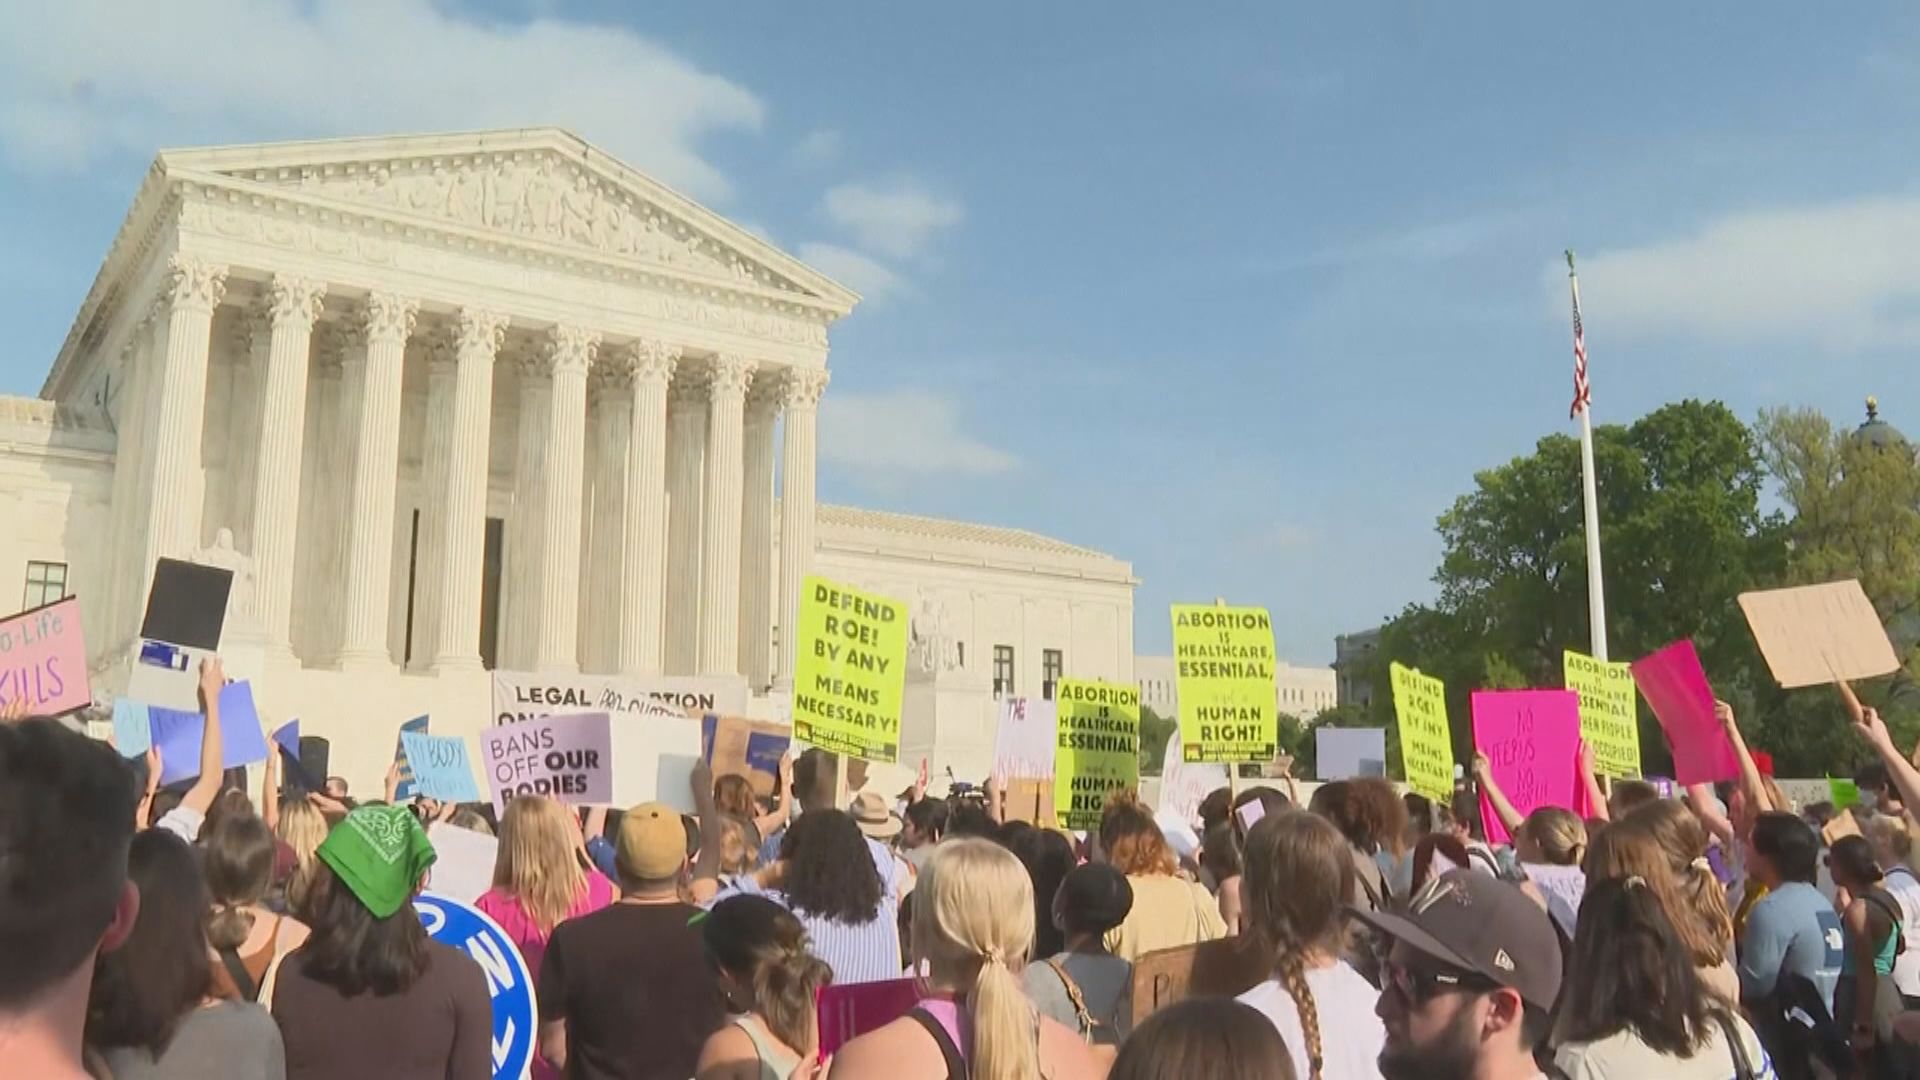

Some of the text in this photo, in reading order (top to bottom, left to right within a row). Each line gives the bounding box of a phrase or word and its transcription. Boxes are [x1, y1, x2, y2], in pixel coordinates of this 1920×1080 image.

[815, 584, 895, 622] DEFEND
[825, 615, 879, 647] ROE!
[1177, 612, 1270, 630] ABORTION
[1219, 632, 1231, 644] IS
[814, 638, 889, 675] BY ANY
[1178, 644, 1273, 660] HEALTHCARE,
[1179, 661, 1274, 681] ESSENTIAL,
[1568, 657, 1631, 680] ABORTION
[515, 686, 592, 707] LEGAL
[815, 674, 879, 706] MEANS
[1060, 684, 1139, 706] ABORTION
[796, 694, 897, 733] NECESSARY!
[1098, 706, 1109, 718] IS
[1197, 706, 1262, 721] HUMAN
[491, 728, 554, 760] BANS
[1059, 733, 1137, 756] ESSENTIAL,
[1201, 725, 1262, 742] RIGHT!
[496, 750, 599, 783] OFF OUR
[501, 774, 588, 808] BODIES
[1071, 777, 1125, 792] HUMAN
[1071, 795, 1102, 811] RIG
